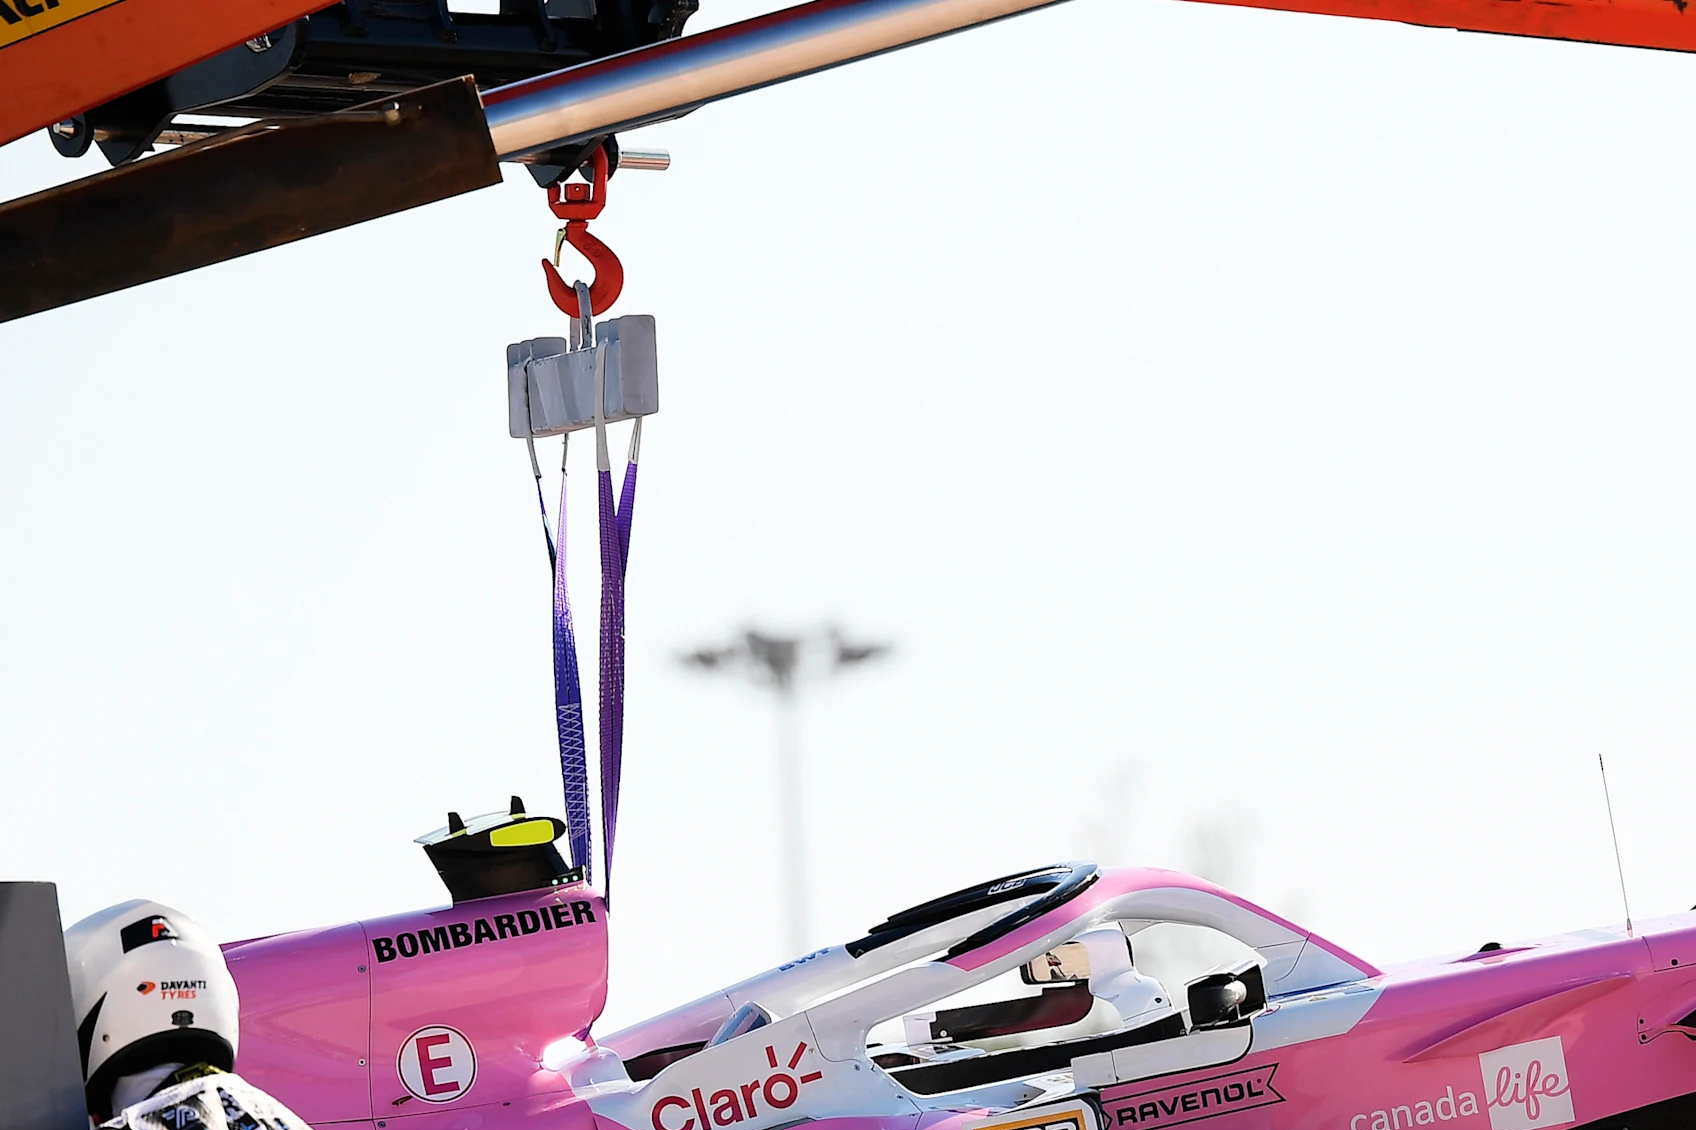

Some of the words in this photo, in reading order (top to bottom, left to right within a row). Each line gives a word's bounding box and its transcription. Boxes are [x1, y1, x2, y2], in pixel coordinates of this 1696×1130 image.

[372, 900, 597, 964] BOMBARDIER
[161, 980, 207, 990] DAVANTI
[161, 990, 196, 1000] TYRES
[415, 1033, 461, 1096] E
[1488, 1060, 1570, 1121] life
